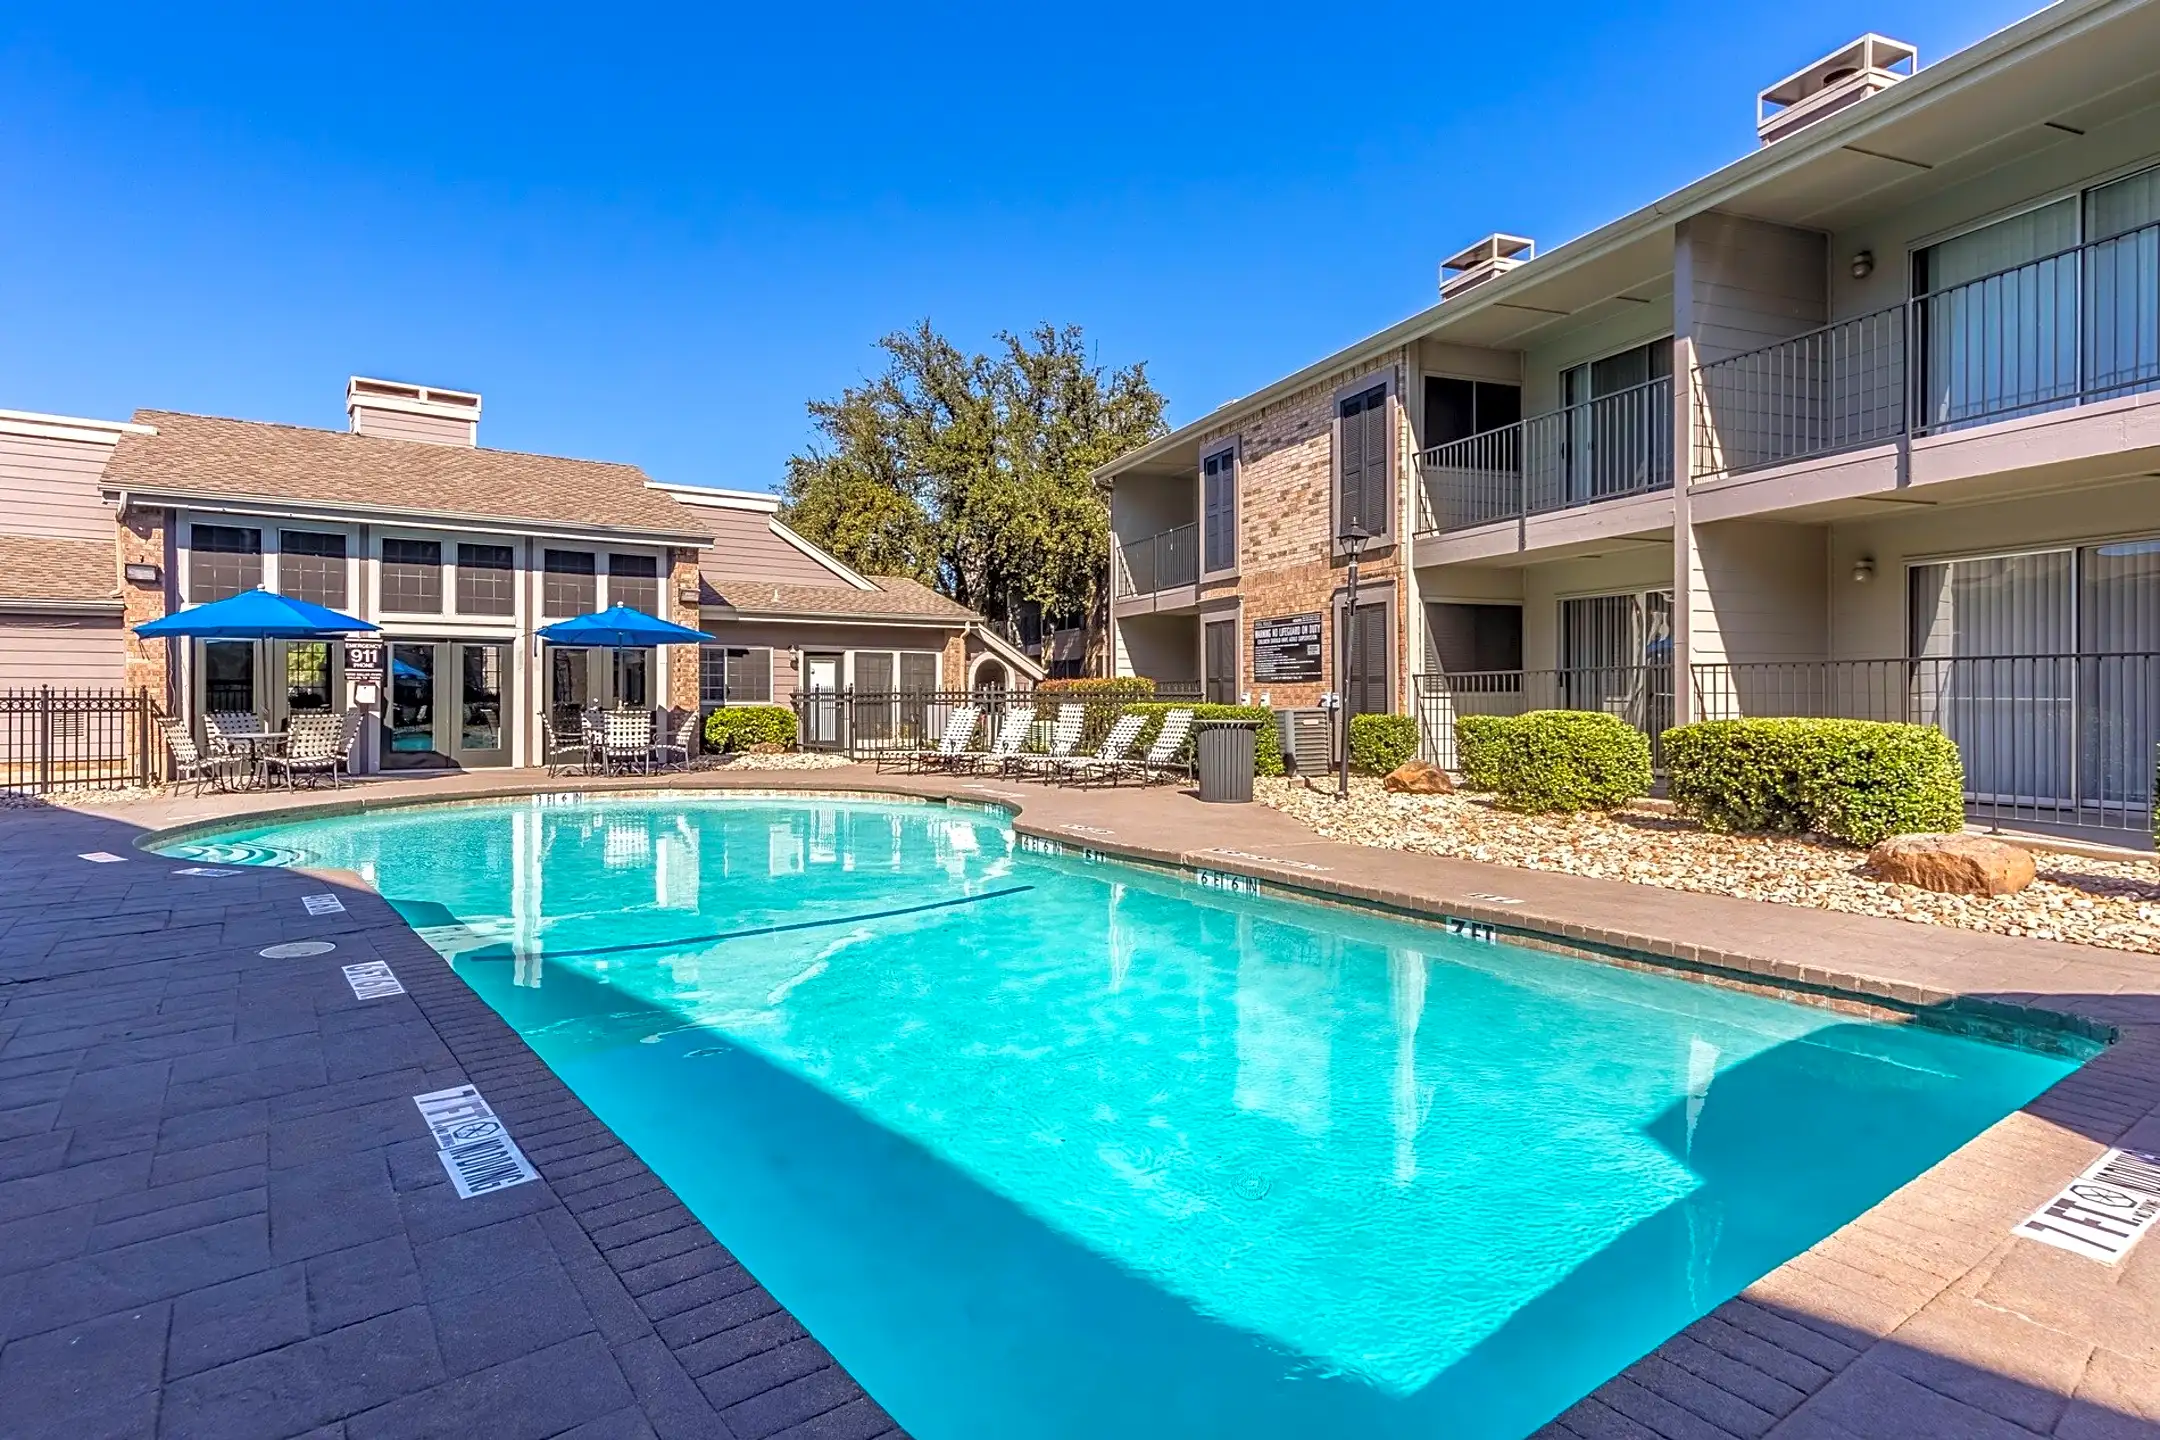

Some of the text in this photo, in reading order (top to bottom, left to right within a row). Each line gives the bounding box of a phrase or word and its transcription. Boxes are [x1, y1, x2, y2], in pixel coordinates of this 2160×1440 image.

[350, 649, 377, 663] 911
[1246, 877, 1257, 892] IN
[1451, 919, 1495, 940] 7 FT
[419, 1089, 490, 1125] 7 FT
[448, 1138, 525, 1193] NO DIVING
[2044, 1198, 2140, 1238] FT
[2025, 1220, 2117, 1253] 7
